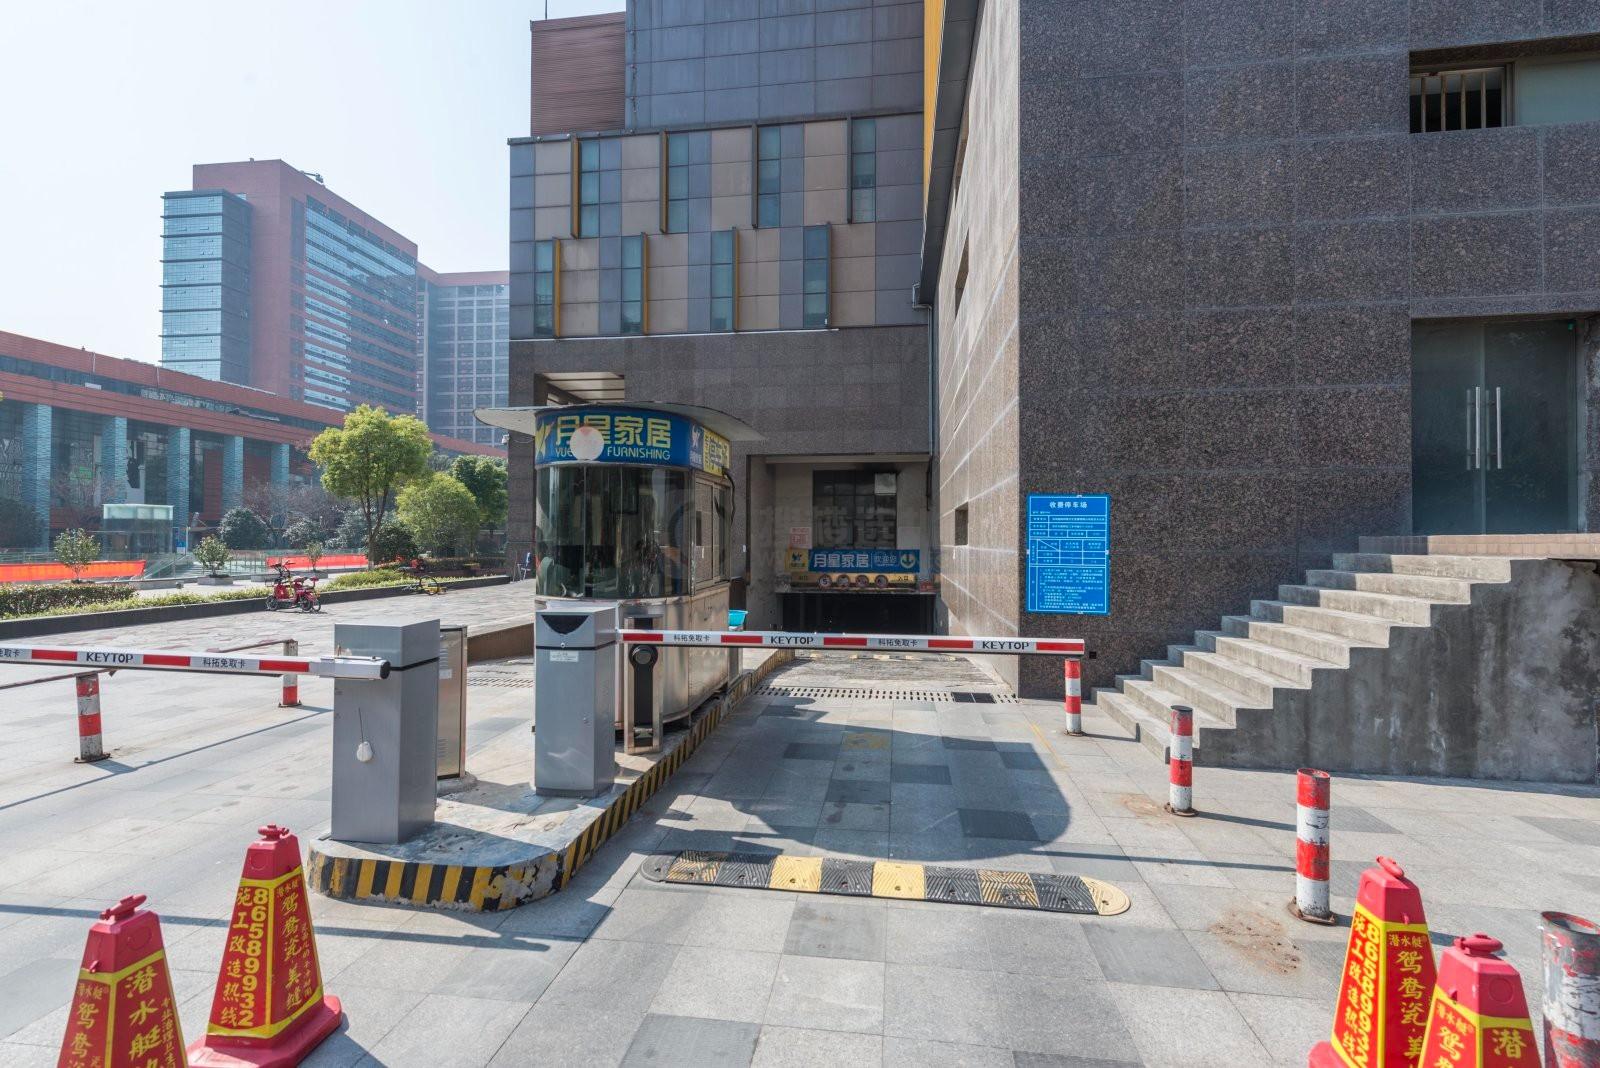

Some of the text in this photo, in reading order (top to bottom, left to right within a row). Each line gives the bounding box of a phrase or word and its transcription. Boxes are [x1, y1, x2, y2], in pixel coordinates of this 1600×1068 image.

[607, 446, 671, 461] FURNISHING
[1049, 501, 1088, 509] 收费停车场
[813, 553, 869, 568] 月星家居
[673, 634, 711, 642] 科拓免取卡
[770, 635, 814, 645] KEYTOP
[878, 638, 918, 647] 科拓免取卡
[982, 640, 1030, 650] KEYTOP
[86, 652, 134, 663] KEYTOP
[202, 657, 246, 669] 科拓免取卡
[1388, 933, 1424, 949] 潜水艇
[238, 888, 270, 1027] 86589932
[1396, 950, 1427, 1068] 鸳鸯瓷·美
[1491, 1029, 1527, 1068] 潜
